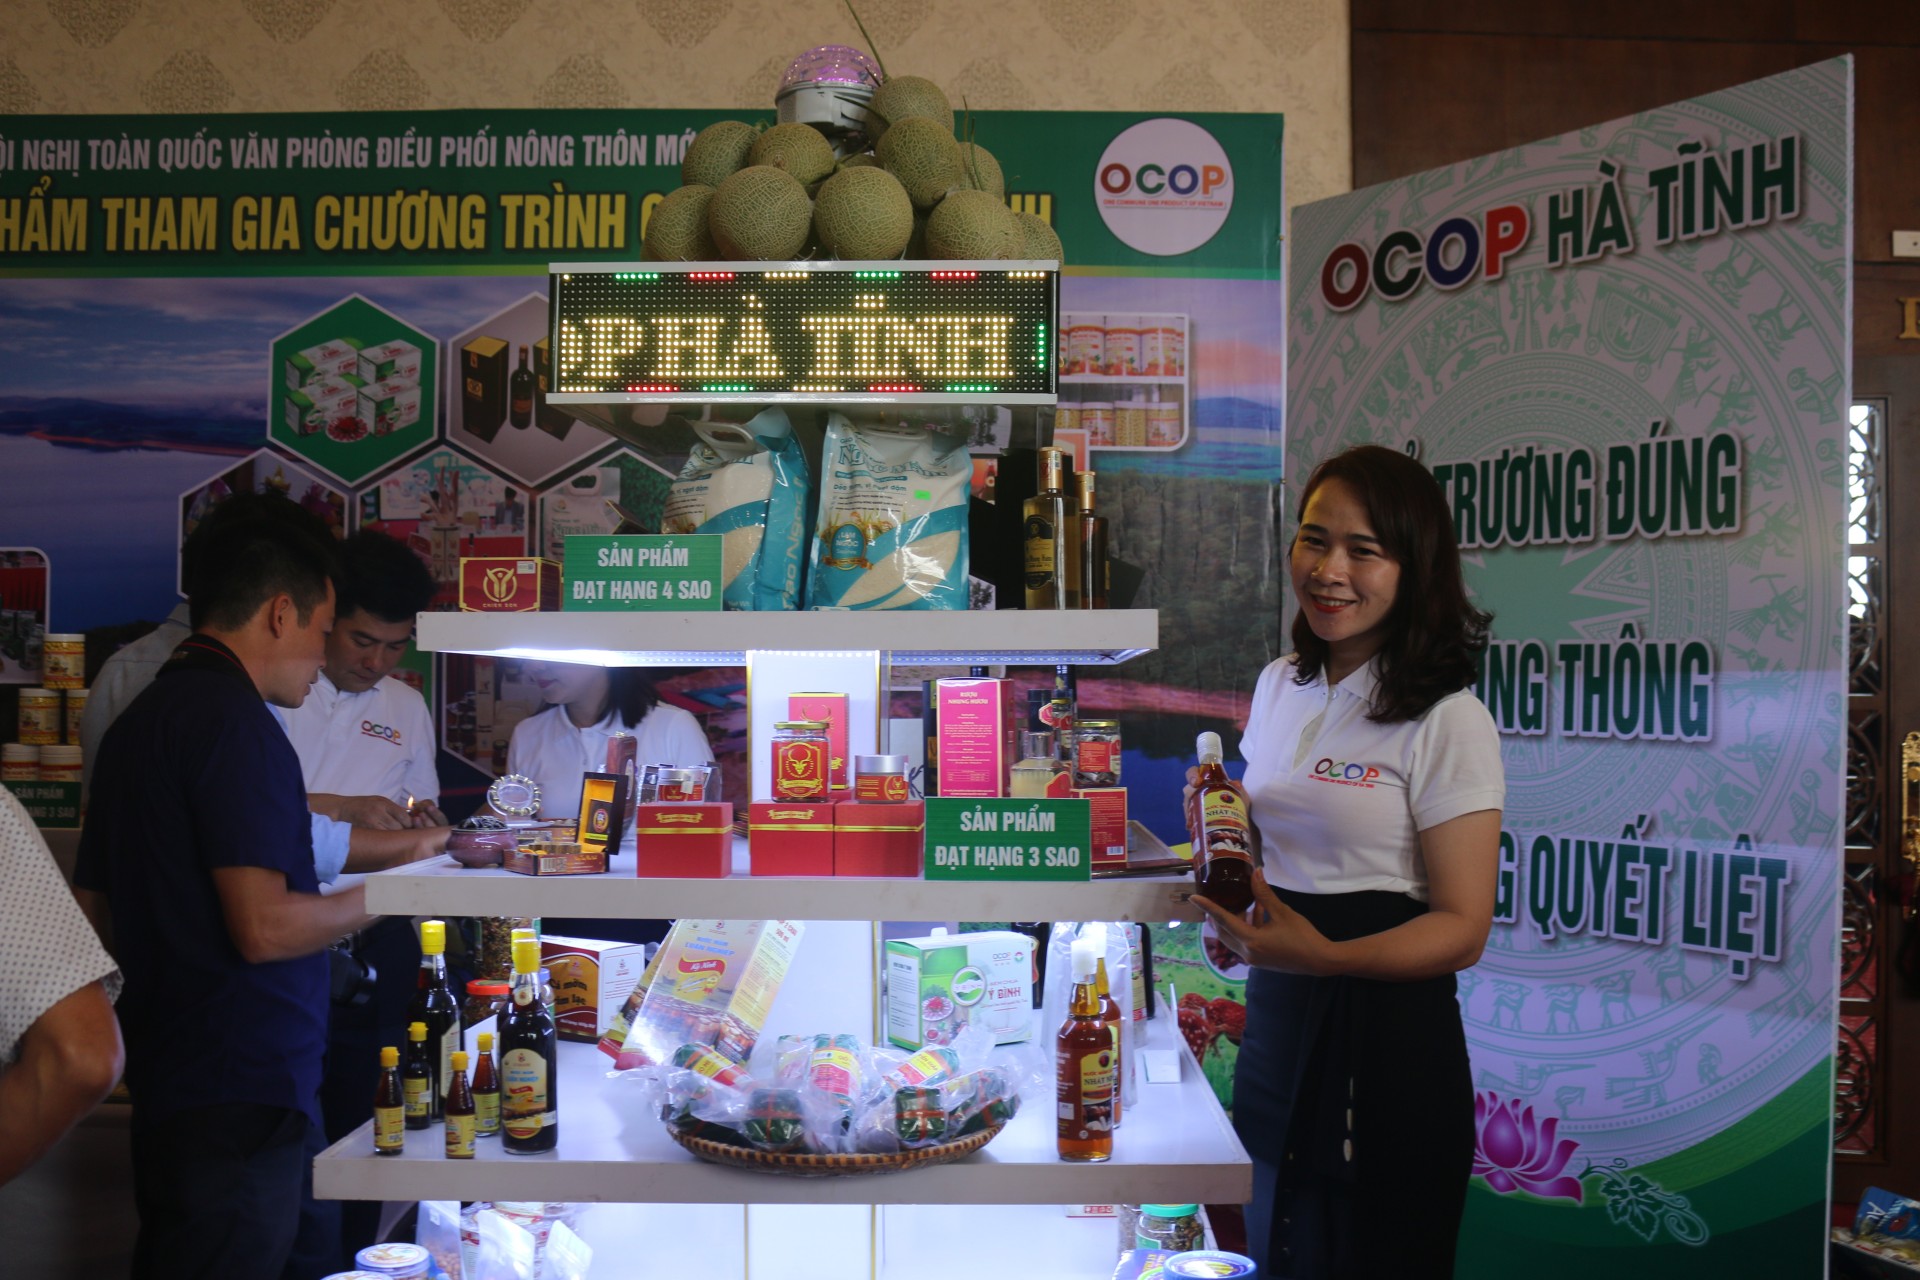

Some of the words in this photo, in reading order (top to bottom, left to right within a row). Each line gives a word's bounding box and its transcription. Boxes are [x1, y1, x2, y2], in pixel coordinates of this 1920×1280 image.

[22, 139, 80, 177] NGHỊ
[88, 132, 150, 170] TOÀN
[158, 127, 222, 170] QUỐC
[230, 131, 279, 169] VĂN
[286, 129, 369, 169] PHÒNG
[376, 124, 431, 169] ĐIỀU
[440, 124, 497, 168] PHỐI
[505, 128, 574, 168] NÔNG
[582, 128, 648, 167] THÔN
[1101, 163, 1225, 195] OCOP
[102, 197, 218, 251] THAM
[232, 196, 301, 250] GIA
[314, 189, 486, 250] CHƯƠNG
[501, 181, 626, 250] TRÌNH
[1321, 205, 1528, 308] OCOP
[1548, 161, 1630, 264] HÀ
[1650, 136, 1796, 243] TĨNH
[649, 294, 785, 377] HÀ
[1433, 446, 1592, 545] TRƯƠNG
[1607, 422, 1737, 536] ĐÚNG
[597, 541, 634, 567] SẢN
[638, 540, 689, 567] PHẨM
[573, 580, 606, 604] ĐẠT
[610, 580, 658, 604] HẠNG
[662, 580, 674, 600] 4
[678, 580, 712, 600] SAO
[1475, 642, 1544, 731] NG
[1559, 622, 1709, 738] THÔNG
[361, 720, 401, 741] OCOP
[1314, 758, 1380, 782] OCOP
[959, 804, 998, 832] SẢN
[1002, 803, 1056, 832] PHẨM
[935, 846, 969, 872] ĐẠT
[974, 846, 1024, 872] HẠNG
[1028, 846, 1041, 867] 3
[1045, 846, 1080, 867] SAO
[1530, 814, 1669, 942] QUYẾT
[1684, 834, 1788, 976] LIỆT
